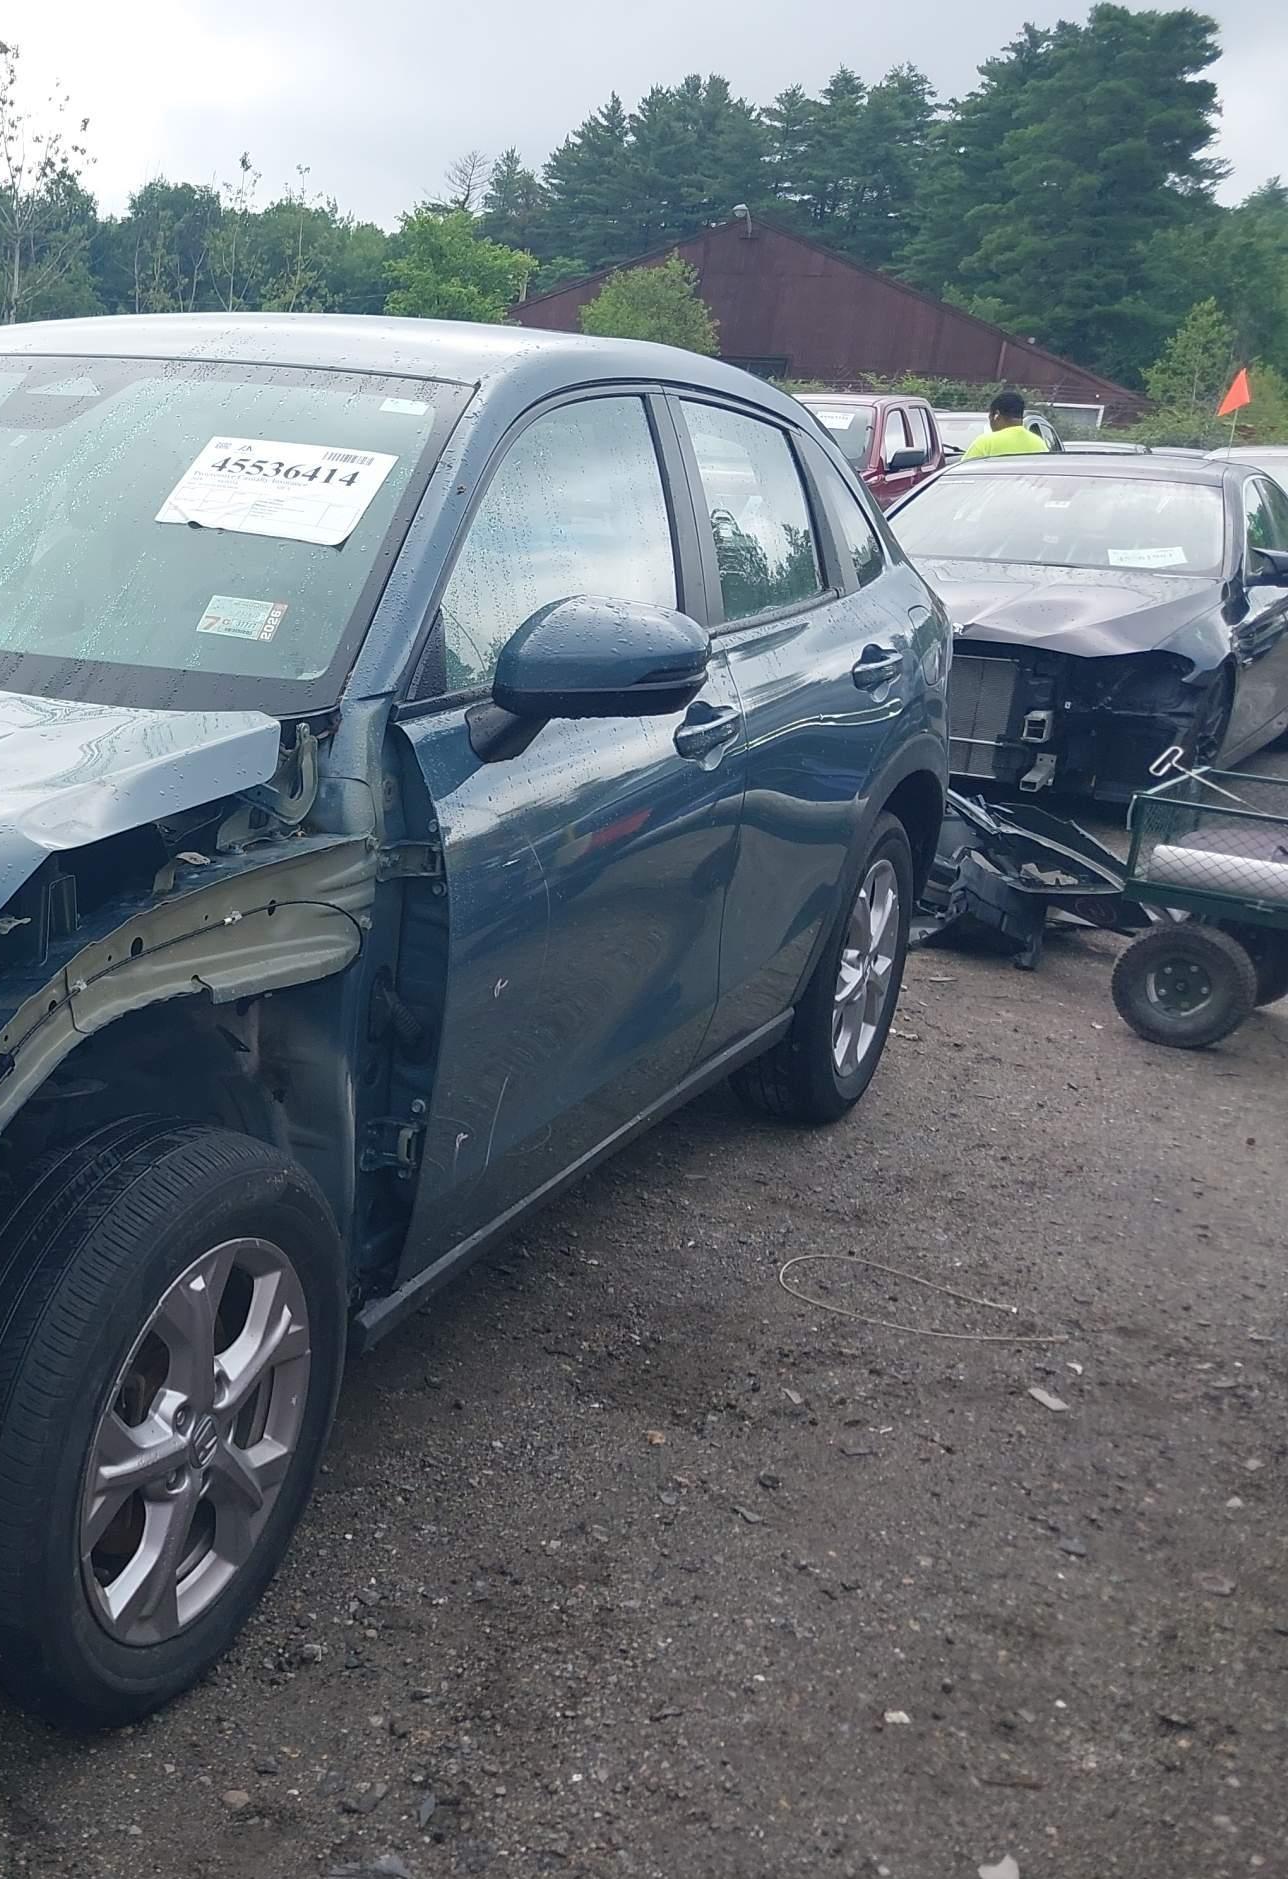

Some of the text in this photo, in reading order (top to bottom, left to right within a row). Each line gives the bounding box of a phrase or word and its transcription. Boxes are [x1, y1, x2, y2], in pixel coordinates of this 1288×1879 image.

[211, 456, 360, 487] 45536414
[203, 615, 221, 631] 7
[260, 609, 282, 640] 2026
